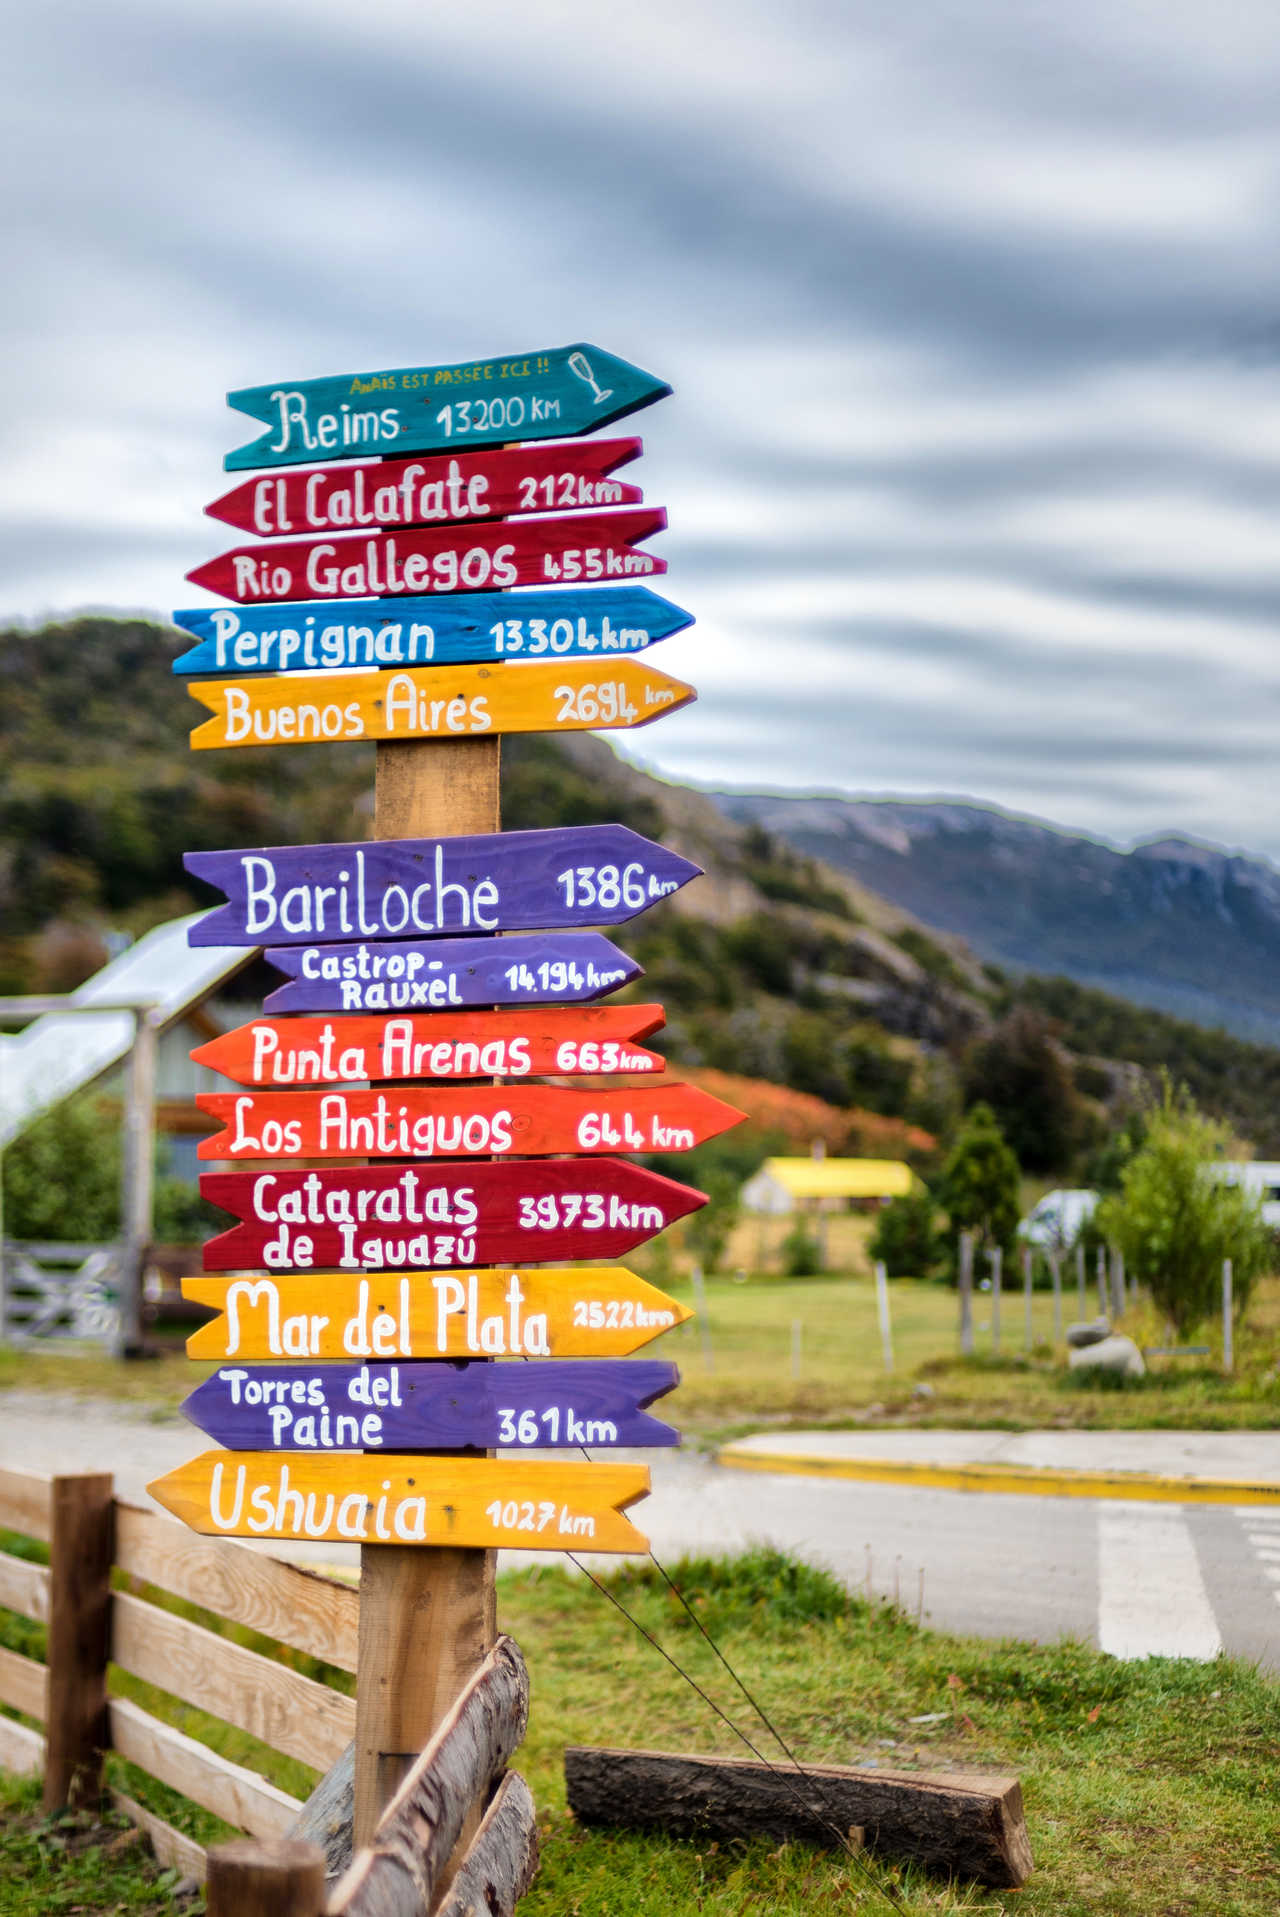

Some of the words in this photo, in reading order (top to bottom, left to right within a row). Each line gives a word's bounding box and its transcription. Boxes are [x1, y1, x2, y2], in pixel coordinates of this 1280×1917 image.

[401, 373, 430, 389] EST
[500, 360, 532, 379] ICI
[270, 391, 399, 452] Reims
[436, 397, 524, 437] 13200
[254, 479, 292, 532] El
[306, 460, 491, 527] Calafate
[233, 556, 291, 597] Rio
[305, 540, 519, 595] Gallegos
[209, 610, 436, 667] Perpignan
[223, 687, 364, 742] Buenos
[385, 673, 492, 732] Aires
[553, 683, 638, 724] 2694
[240, 844, 499, 936] Bariloche
[302, 949, 444, 979] Castrop-
[340, 974, 464, 1010] Rauxel
[252, 1025, 368, 1082] Punta
[382, 1019, 532, 1077] Arenas
[229, 1096, 302, 1154] Los
[319, 1094, 513, 1157] Antiguos
[253, 1170, 478, 1227] Cataratas
[263, 1223, 314, 1268] de
[338, 1221, 478, 1268] Iguazú
[225, 1279, 330, 1357] Mar
[343, 1278, 412, 1356] del
[431, 1274, 551, 1357] Plata
[218, 1369, 326, 1407] Torres
[347, 1366, 403, 1407] del
[268, 1406, 384, 1446] Paine
[208, 1463, 427, 1540] Ushuaia
